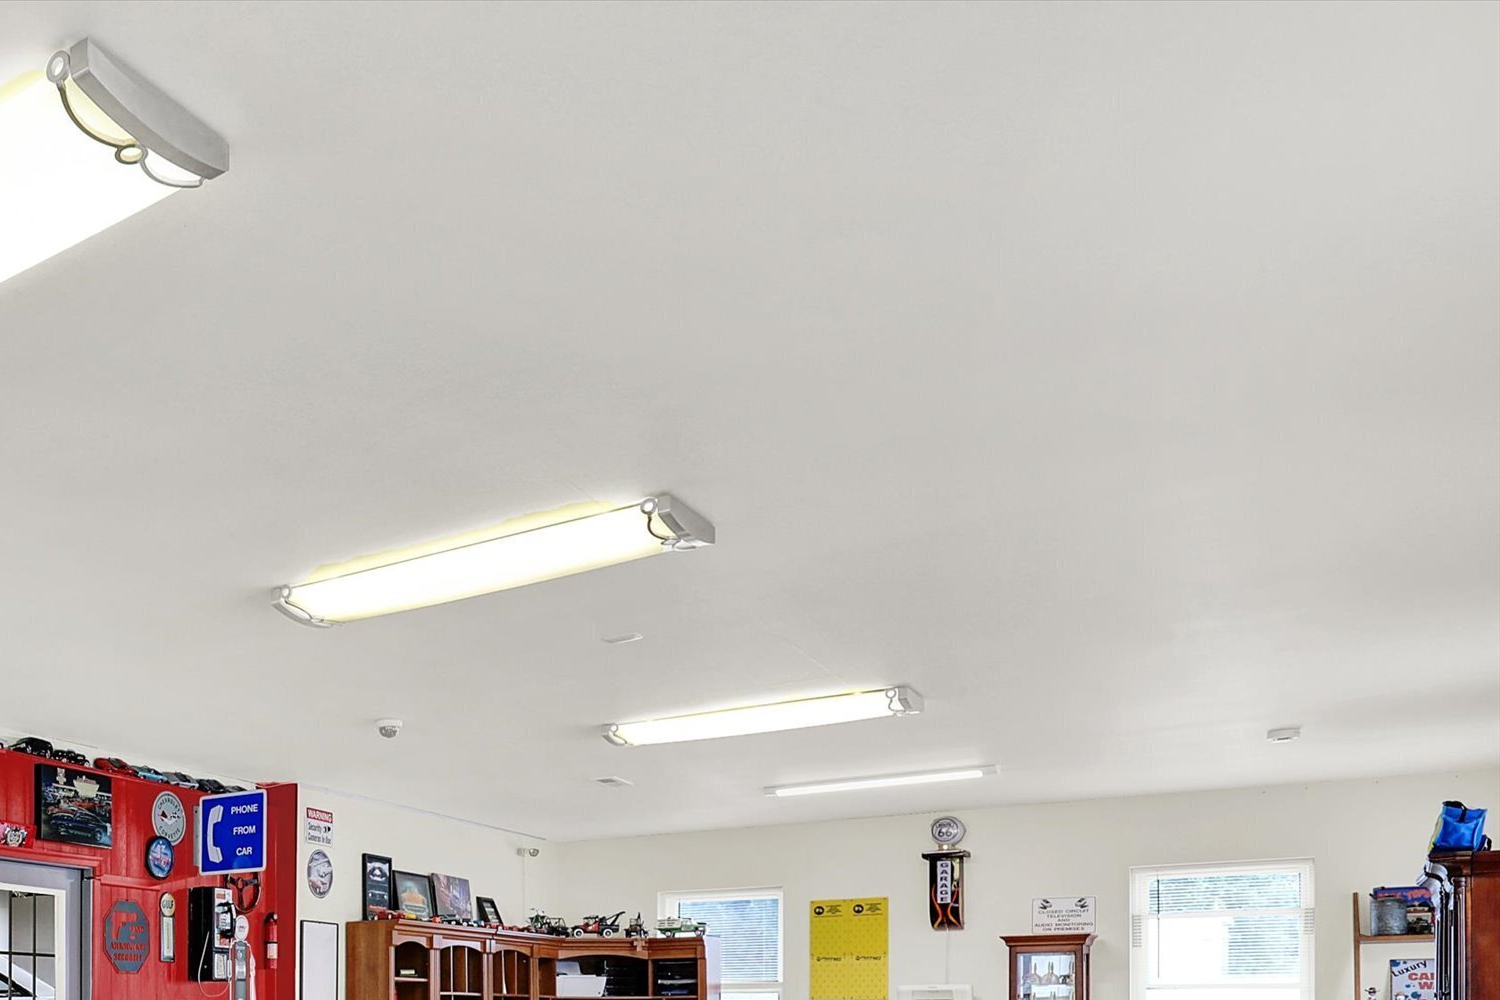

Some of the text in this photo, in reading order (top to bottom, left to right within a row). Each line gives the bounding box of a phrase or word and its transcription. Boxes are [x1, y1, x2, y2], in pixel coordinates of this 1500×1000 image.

[230, 804, 259, 815] PHONE
[307, 809, 332, 823] WARNING
[232, 825, 256, 836] FROM
[937, 827, 953, 838] 66
[235, 847, 253, 856] CAR
[940, 862, 949, 902] GARAGE
[1390, 960, 1428, 978] Luxury
